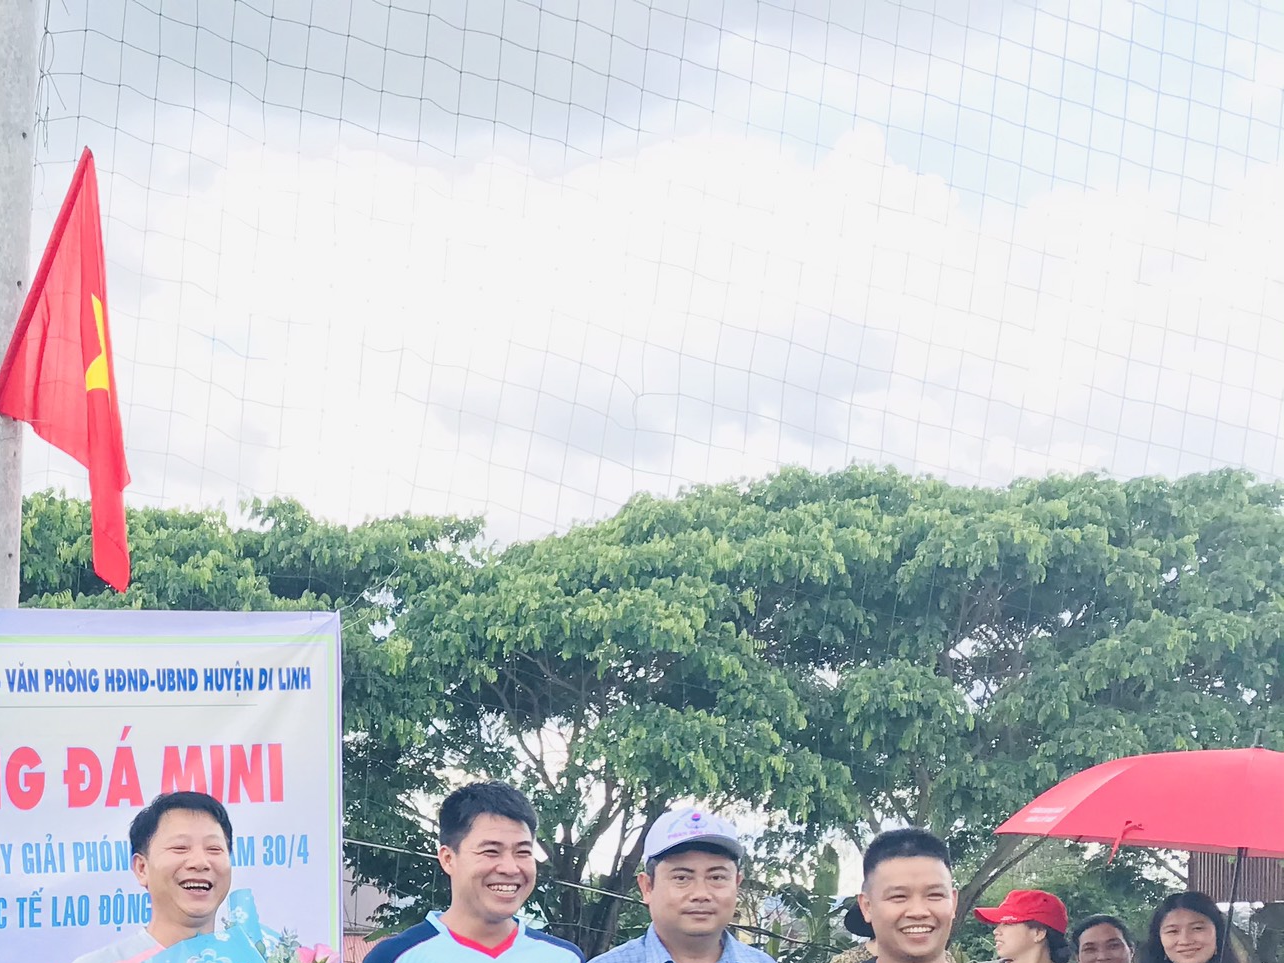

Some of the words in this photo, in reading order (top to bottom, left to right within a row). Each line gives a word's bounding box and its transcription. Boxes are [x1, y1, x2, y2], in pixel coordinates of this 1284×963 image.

[5, 661, 39, 692] VĂN
[44, 660, 100, 692] PHÒNG
[105, 667, 198, 692] HĐND-UBND
[204, 660, 254, 698] HUYỆN
[258, 667, 274, 692] DI
[278, 666, 312, 690] LINH
[63, 726, 144, 808] ĐÁ
[160, 743, 284, 804] MINI
[22, 834, 66, 874] GIẢI
[73, 835, 136, 872] PHÓN
[262, 834, 309, 869] 30/4
[16, 887, 43, 928] TẾ
[52, 895, 90, 928] LAO
[99, 888, 152, 932] ĐỘNG
